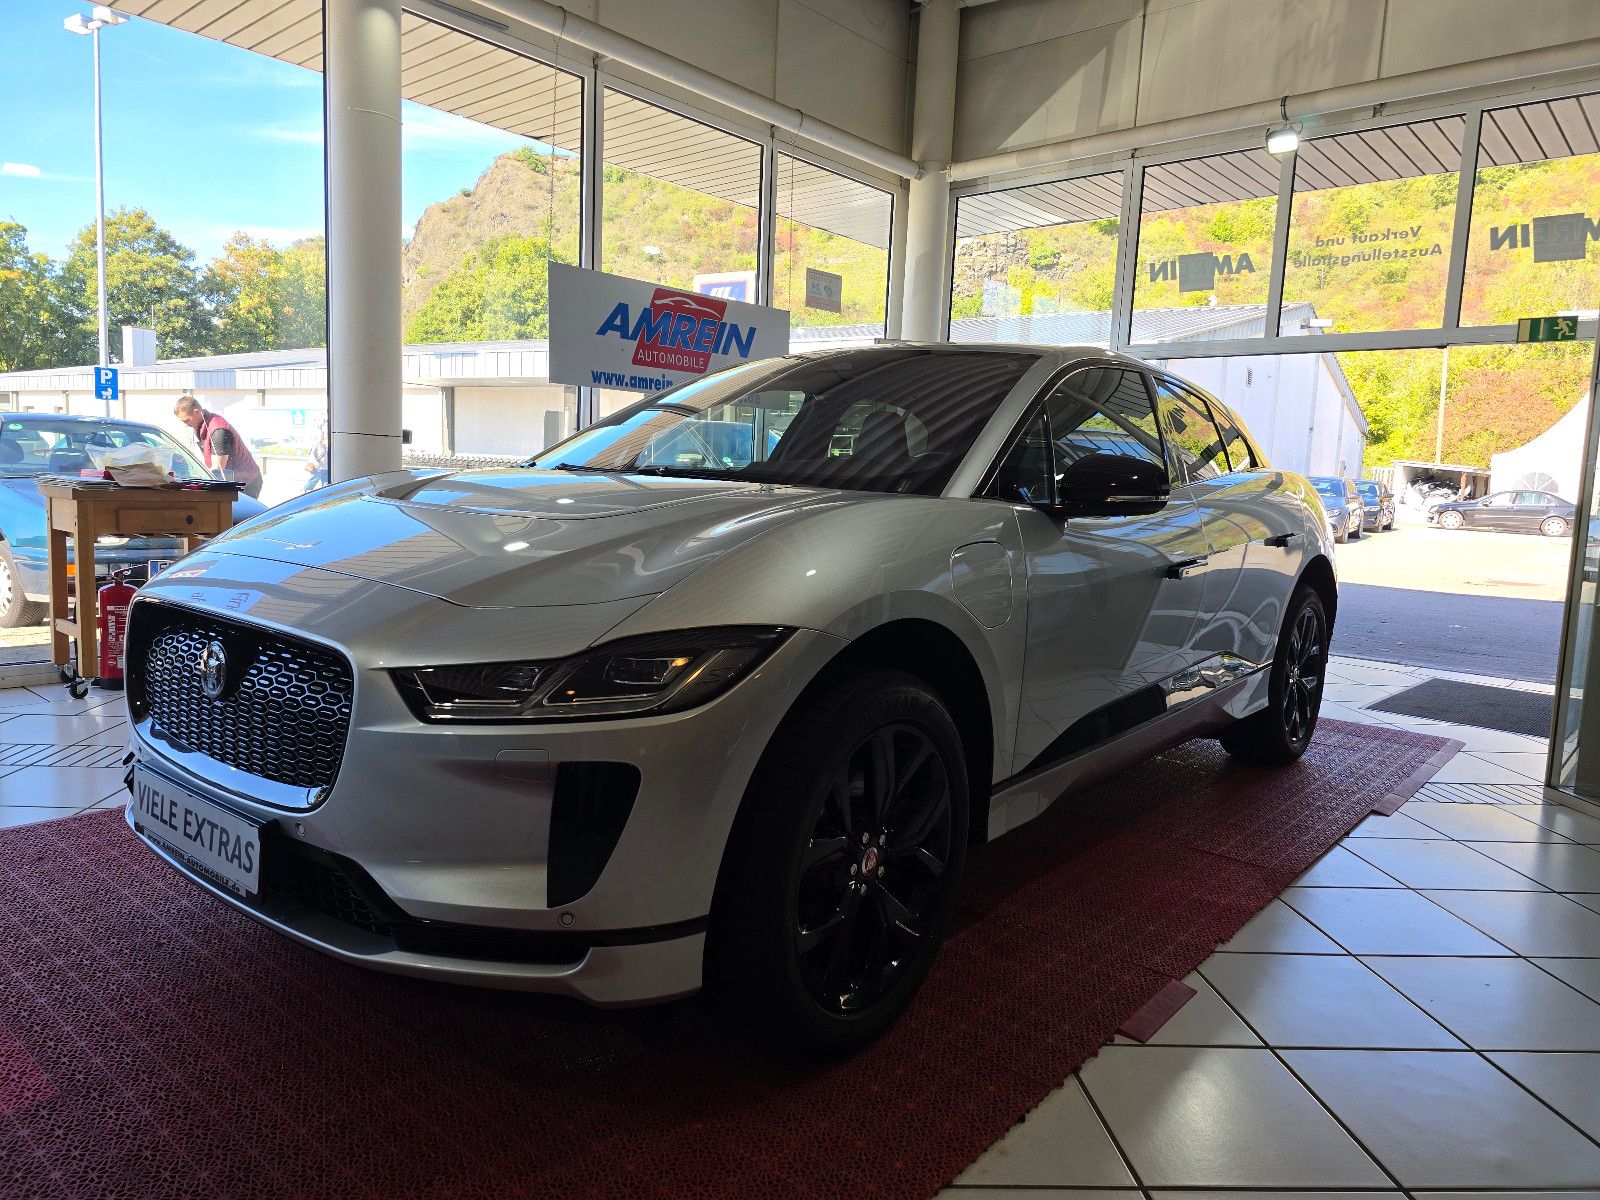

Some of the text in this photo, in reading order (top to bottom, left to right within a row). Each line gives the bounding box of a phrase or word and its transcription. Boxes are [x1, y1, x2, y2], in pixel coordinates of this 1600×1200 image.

[596, 302, 757, 359] AMREIN
[100, 369, 113, 385] P
[637, 349, 705, 369] AUTOMOBILE
[137, 780, 255, 874] VIELE EXTRAS
